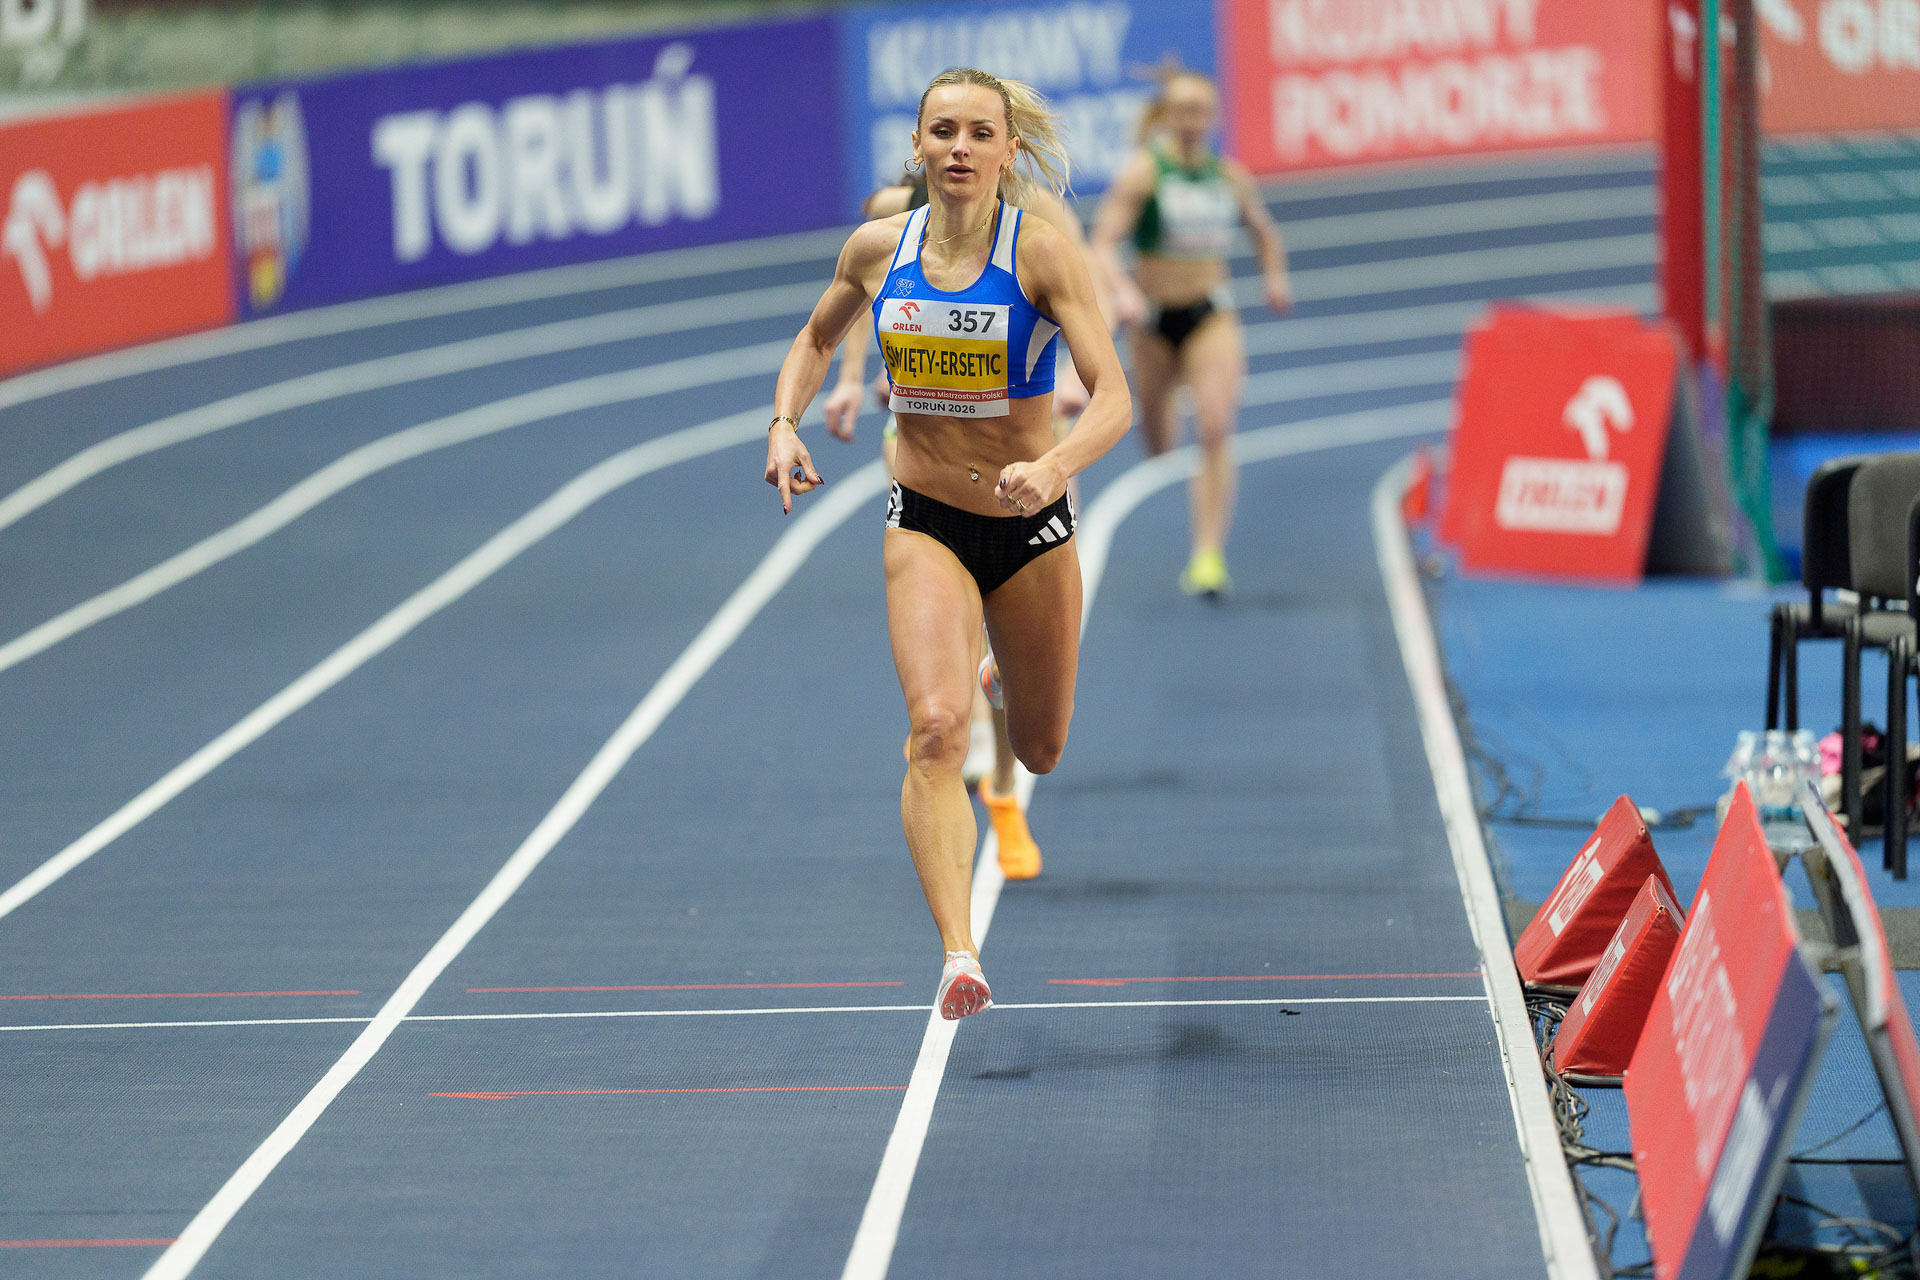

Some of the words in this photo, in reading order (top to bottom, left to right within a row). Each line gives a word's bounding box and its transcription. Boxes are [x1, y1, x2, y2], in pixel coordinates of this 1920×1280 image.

[370, 42, 717, 263] TORUŃ
[892, 322, 922, 333] ORLEN
[948, 309, 996, 333] 357
[885, 340, 1001, 378] ŚWIĘTY-ERSETIC
[909, 389, 936, 397] Halowe
[937, 391, 980, 400] Mistrzostwa
[981, 391, 1003, 400] Polski
[906, 401, 946, 411] TORUŃ
[948, 404, 976, 414] 2026
